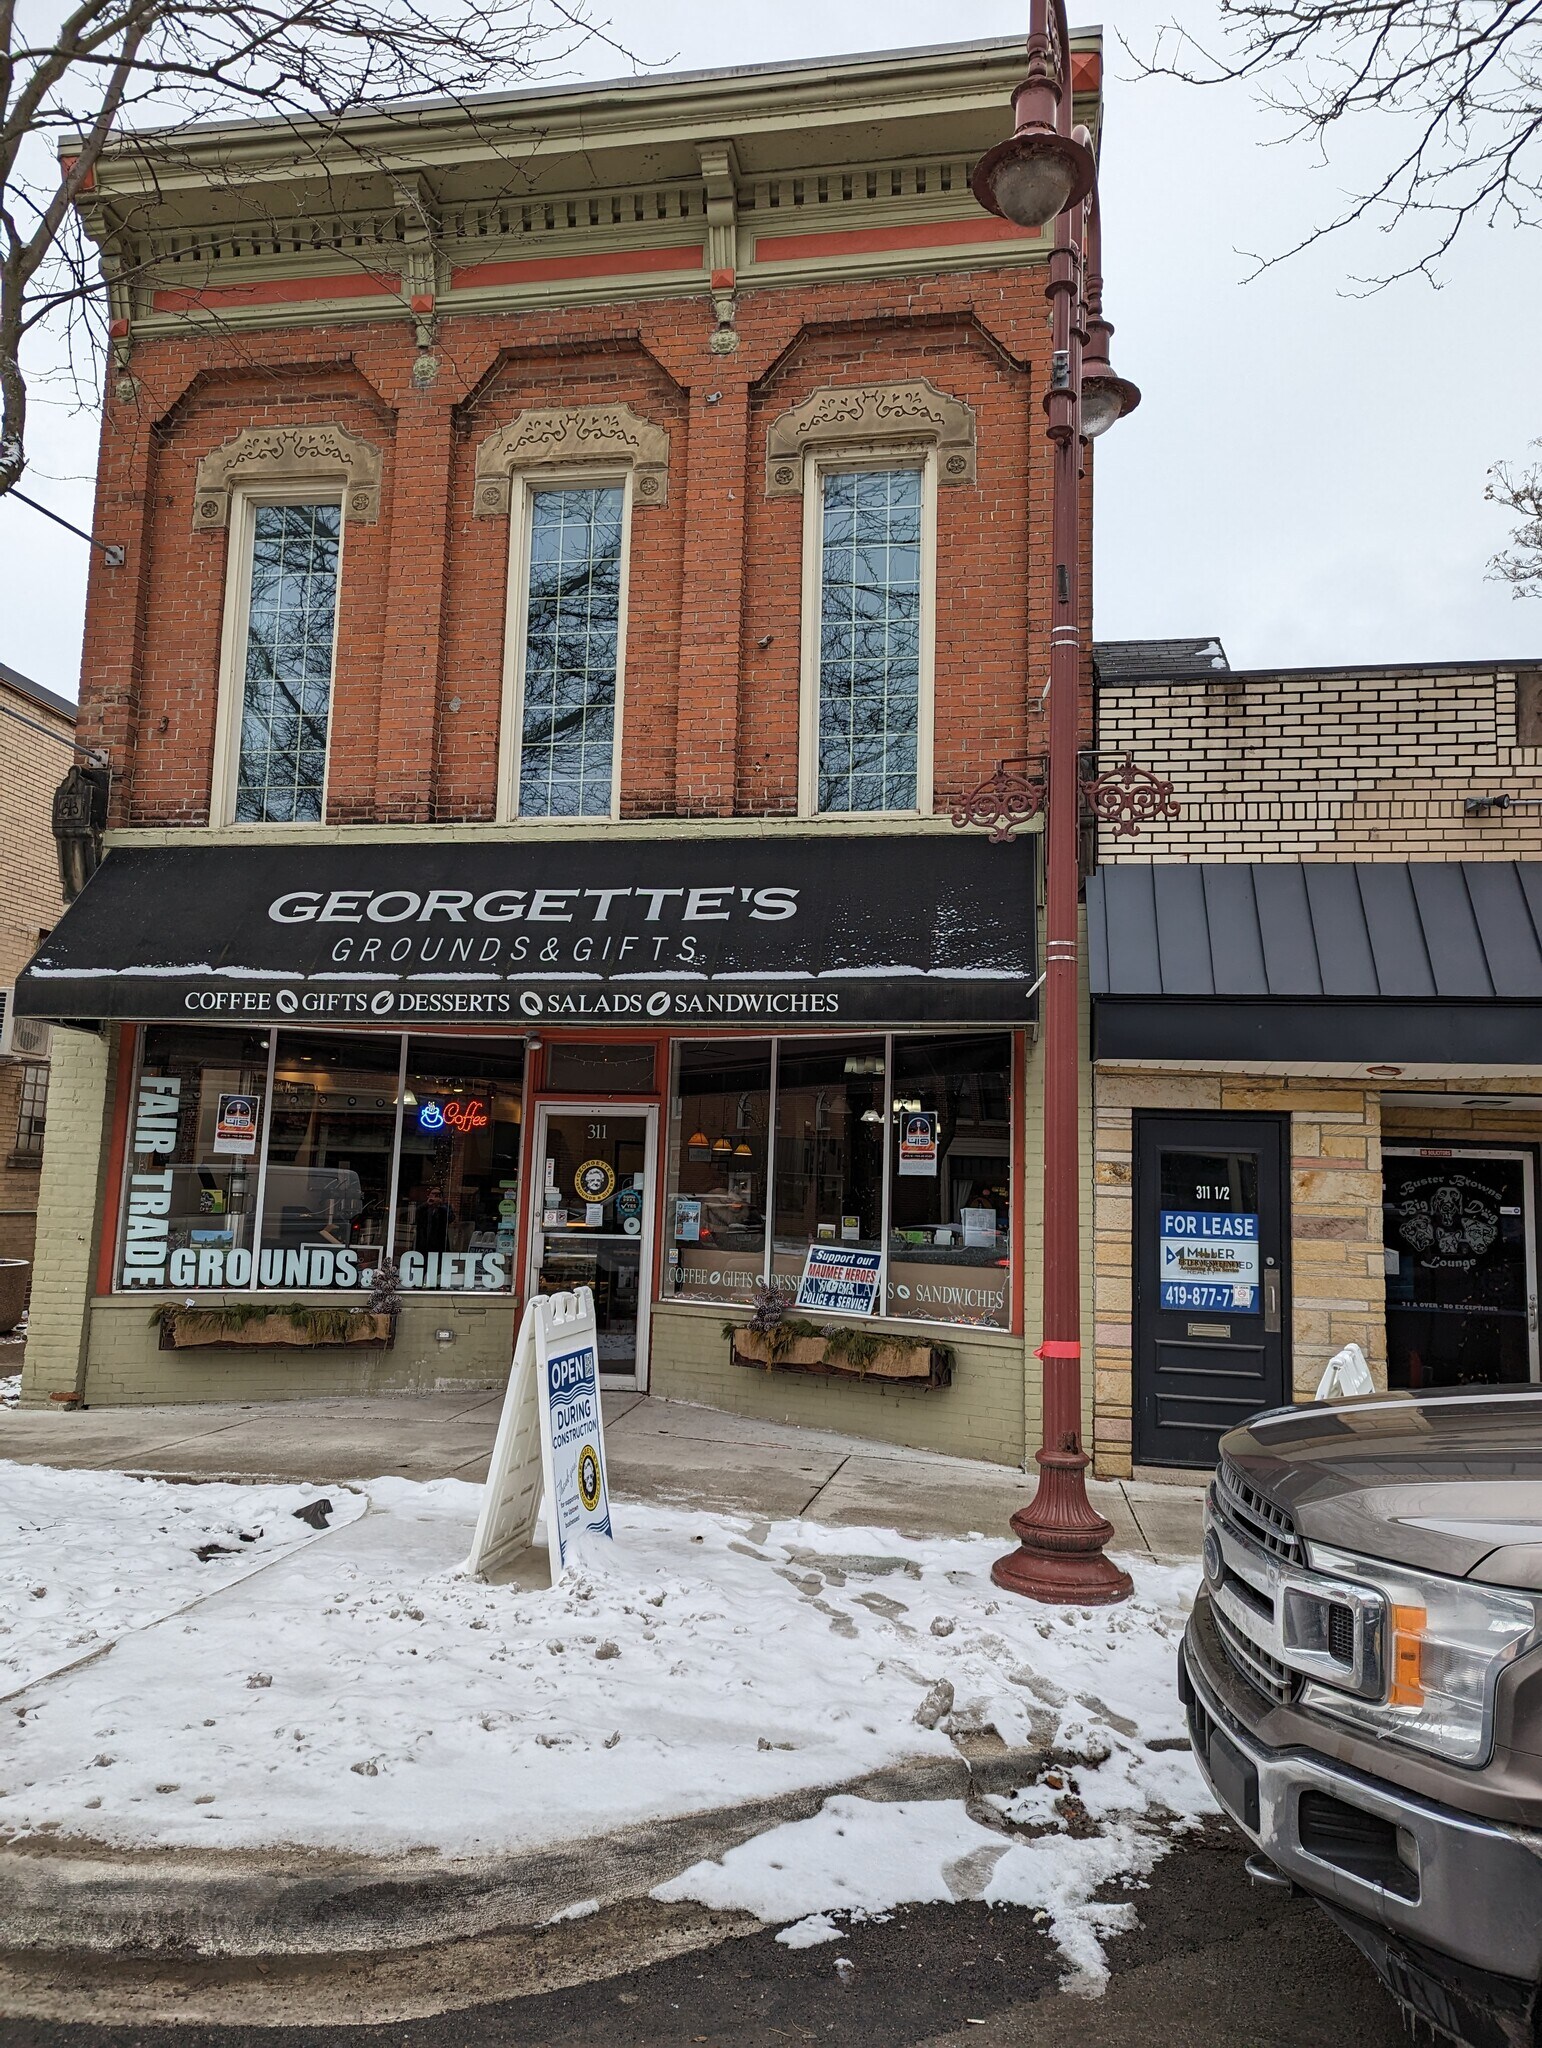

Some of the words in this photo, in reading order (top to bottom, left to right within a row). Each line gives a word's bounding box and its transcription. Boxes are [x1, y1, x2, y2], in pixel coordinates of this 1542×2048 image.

[268, 885, 800, 923] GEORGETTE'S
[331, 936, 529, 962] GROUNDS
[539, 937, 560, 962] &
[573, 936, 698, 962] GIFTS
[184, 991, 271, 1011] COFFEE
[302, 992, 367, 1012] GIFTS
[398, 993, 510, 1013] DESSERTS
[547, 994, 642, 1013] SALADS
[675, 994, 839, 1013] SANDWICHES
[135, 1076, 181, 1153] FAIR
[442, 1101, 488, 1132] Coffee
[587, 1124, 607, 1139] 311
[576, 1160, 614, 1178] GEORGETTE'S
[1196, 1185, 1211, 1200] 311
[1214, 1186, 1230, 1200] 1/2
[1399, 1176, 1445, 1196] Buster
[1448, 1175, 1503, 1200] Browns
[1399, 1200, 1429, 1216] Big
[123, 1169, 174, 1286] TRADE
[1165, 1215, 1197, 1235] FOR
[1202, 1217, 1254, 1237] LEASE
[816, 1250, 856, 1264] Support
[856, 1256, 875, 1266] our
[1187, 1247, 1235, 1259] MILLER
[1420, 1256, 1477, 1274] Lounge
[169, 1248, 358, 1287] GROUNDS
[360, 1268, 374, 1287] &
[400, 1250, 505, 1289] GIFTS
[807, 1263, 844, 1280] MAUMEE
[845, 1267, 877, 1283] HEROES
[668, 1266, 708, 1285] COFFEE
[722, 1270, 754, 1289] GIFTS
[916, 1284, 1004, 1310] SANDWICHES
[1165, 1285, 1254, 1309] 419-877-77
[801, 1291, 829, 1306] POLICE
[828, 1295, 836, 1307] &
[836, 1296, 869, 1311] SERVICE
[551, 1355, 584, 1390] OPEN
[557, 1399, 591, 1430] DURING
[553, 1418, 597, 1450] CONSTRUCTION
